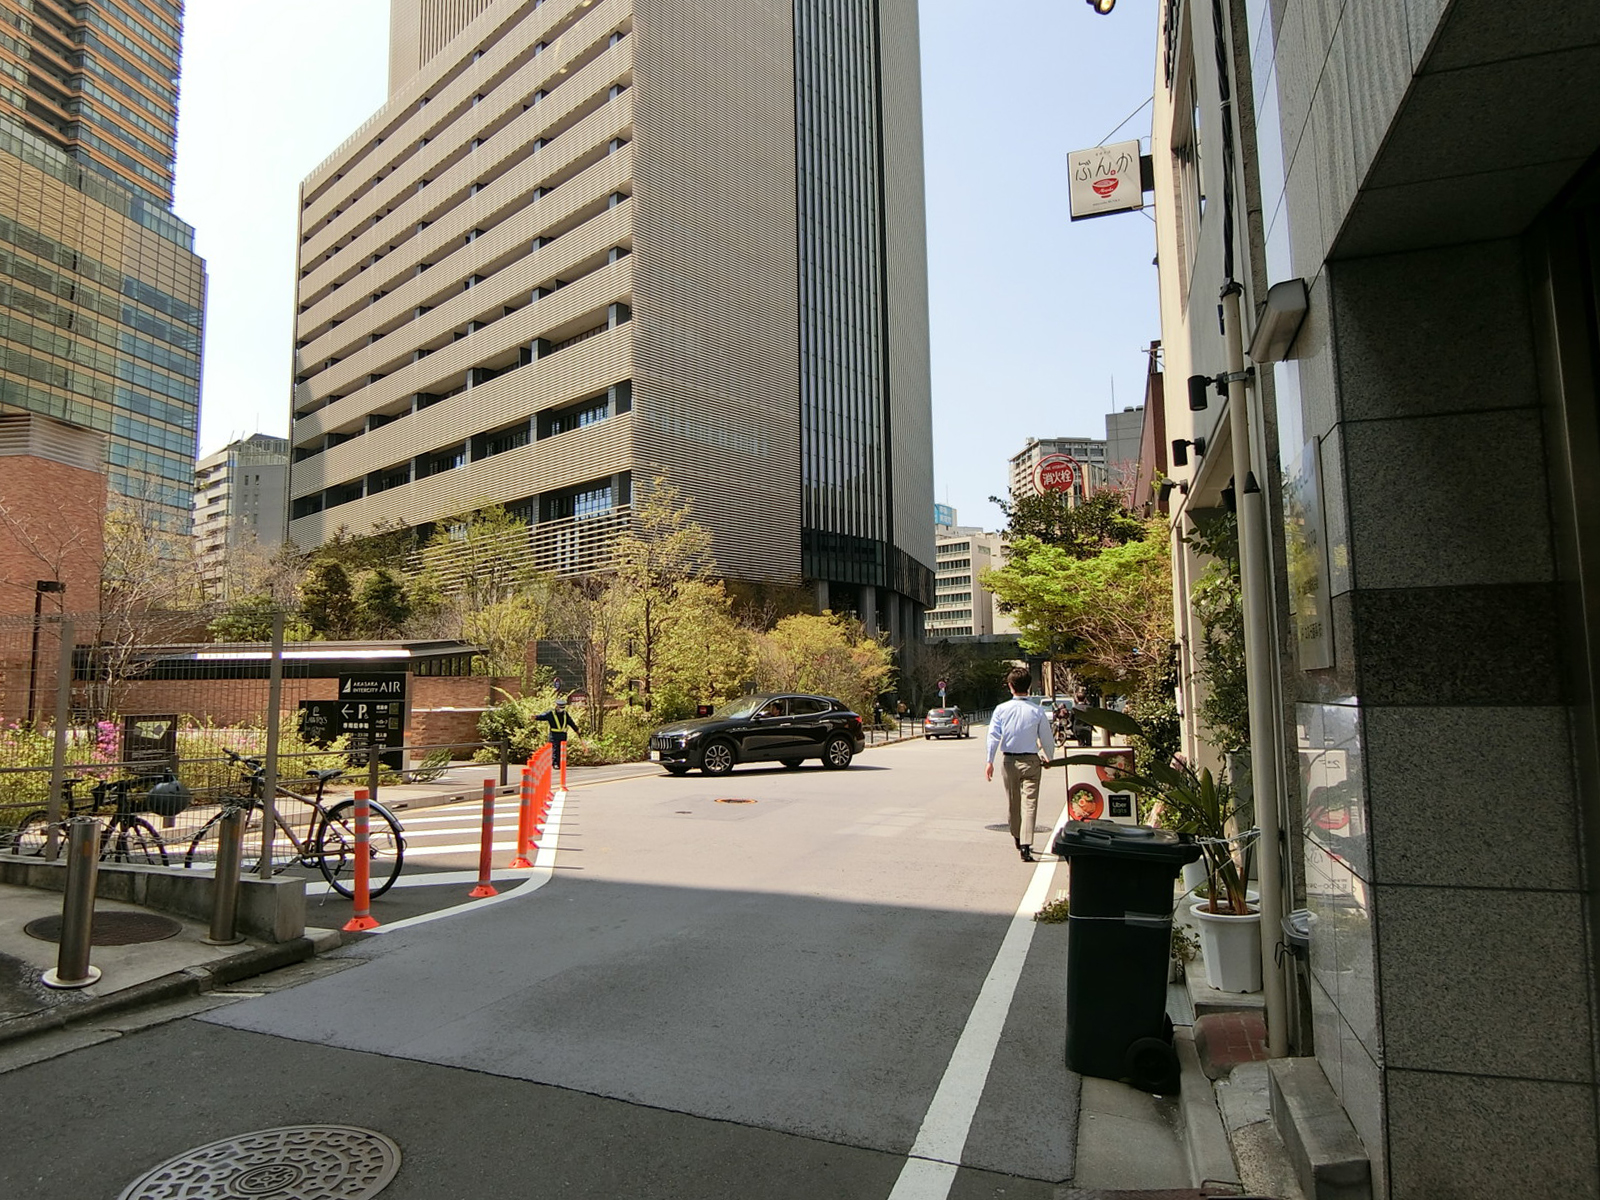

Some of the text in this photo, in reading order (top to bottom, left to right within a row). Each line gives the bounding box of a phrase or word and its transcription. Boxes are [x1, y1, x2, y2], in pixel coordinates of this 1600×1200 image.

[1042, 469, 1072, 486] 消火栓
[379, 681, 401, 693] AIR
[358, 704, 368, 719] P
